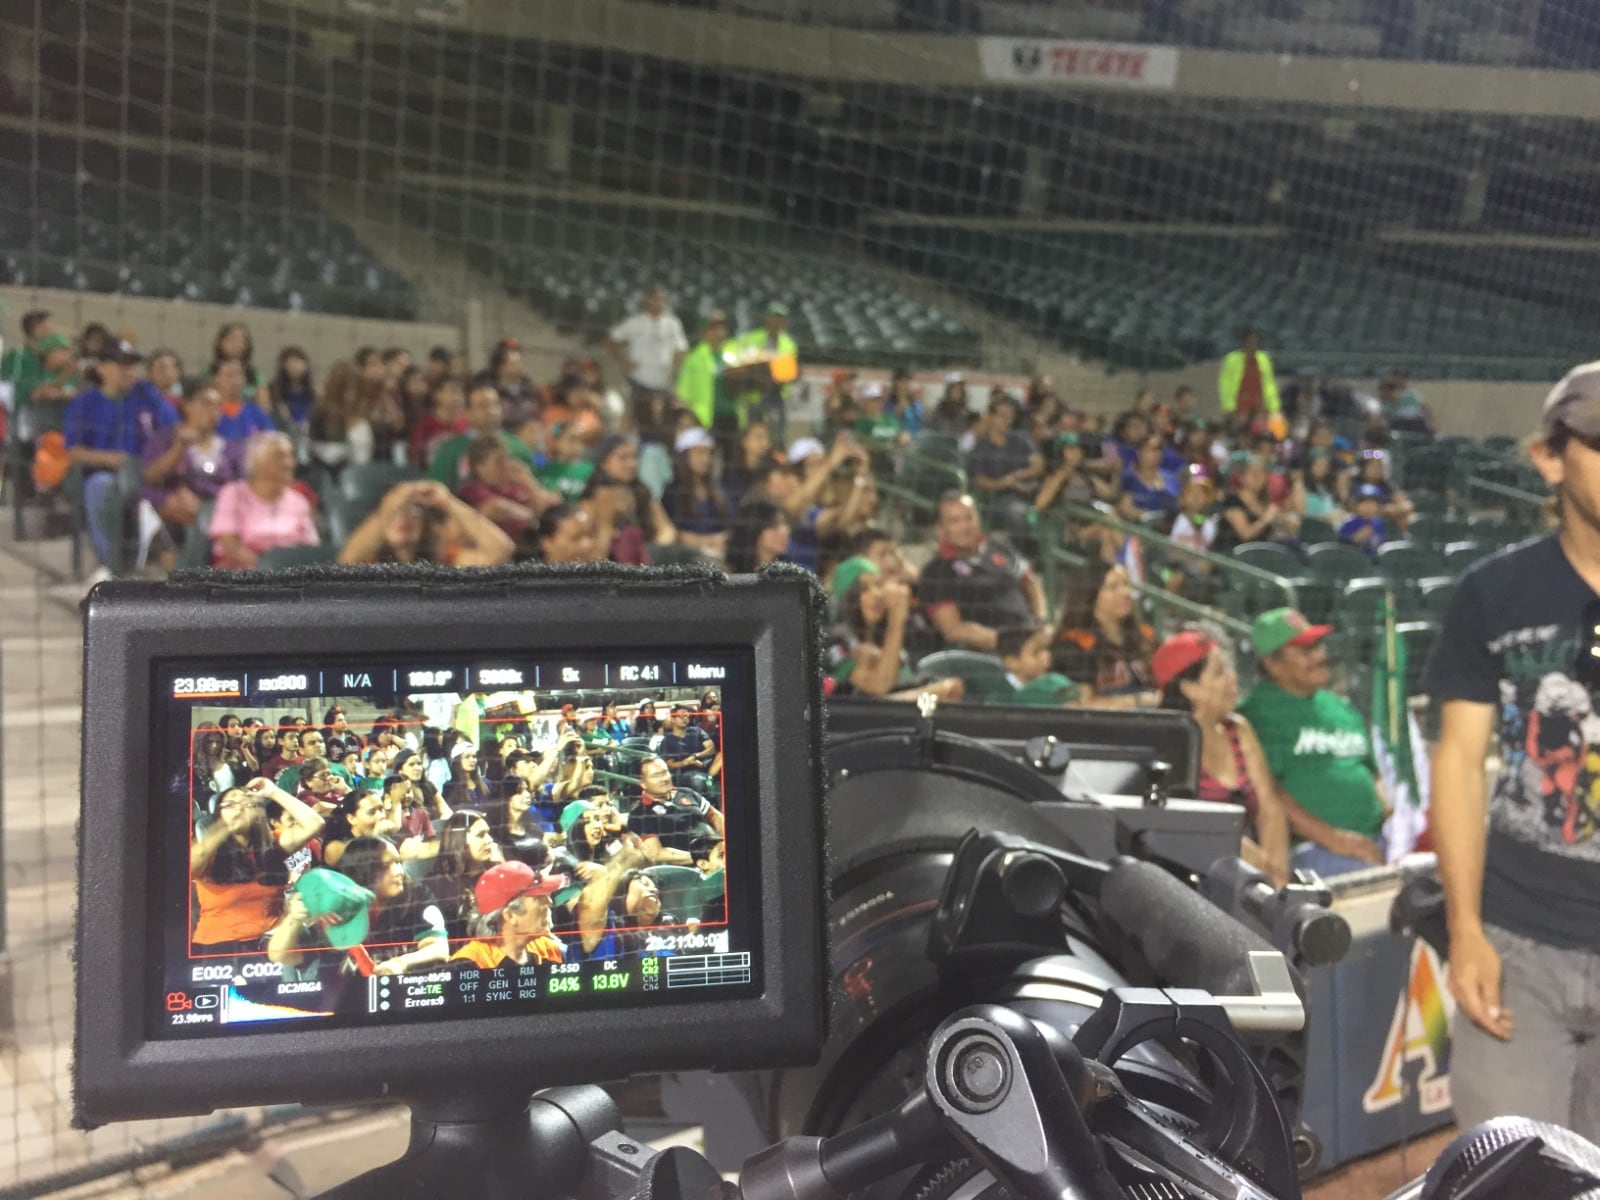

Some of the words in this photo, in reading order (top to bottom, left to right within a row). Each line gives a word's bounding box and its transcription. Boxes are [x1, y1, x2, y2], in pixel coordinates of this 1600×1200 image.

[1050, 45, 1149, 80] TECATE
[641, 664, 660, 681] 4:1
[687, 663, 726, 679] Menu
[344, 673, 373, 688] N/A
[603, 960, 618, 971] DC
[459, 970, 480, 981] HDR
[493, 968, 505, 978] TC
[459, 981, 479, 992] OFF
[488, 979, 509, 990] GEN
[517, 977, 537, 988] LAN
[549, 976, 581, 993] 84%
[463, 993, 476, 1003] 1:1
[485, 990, 512, 1002] SYNC
[519, 988, 536, 999] RIG
